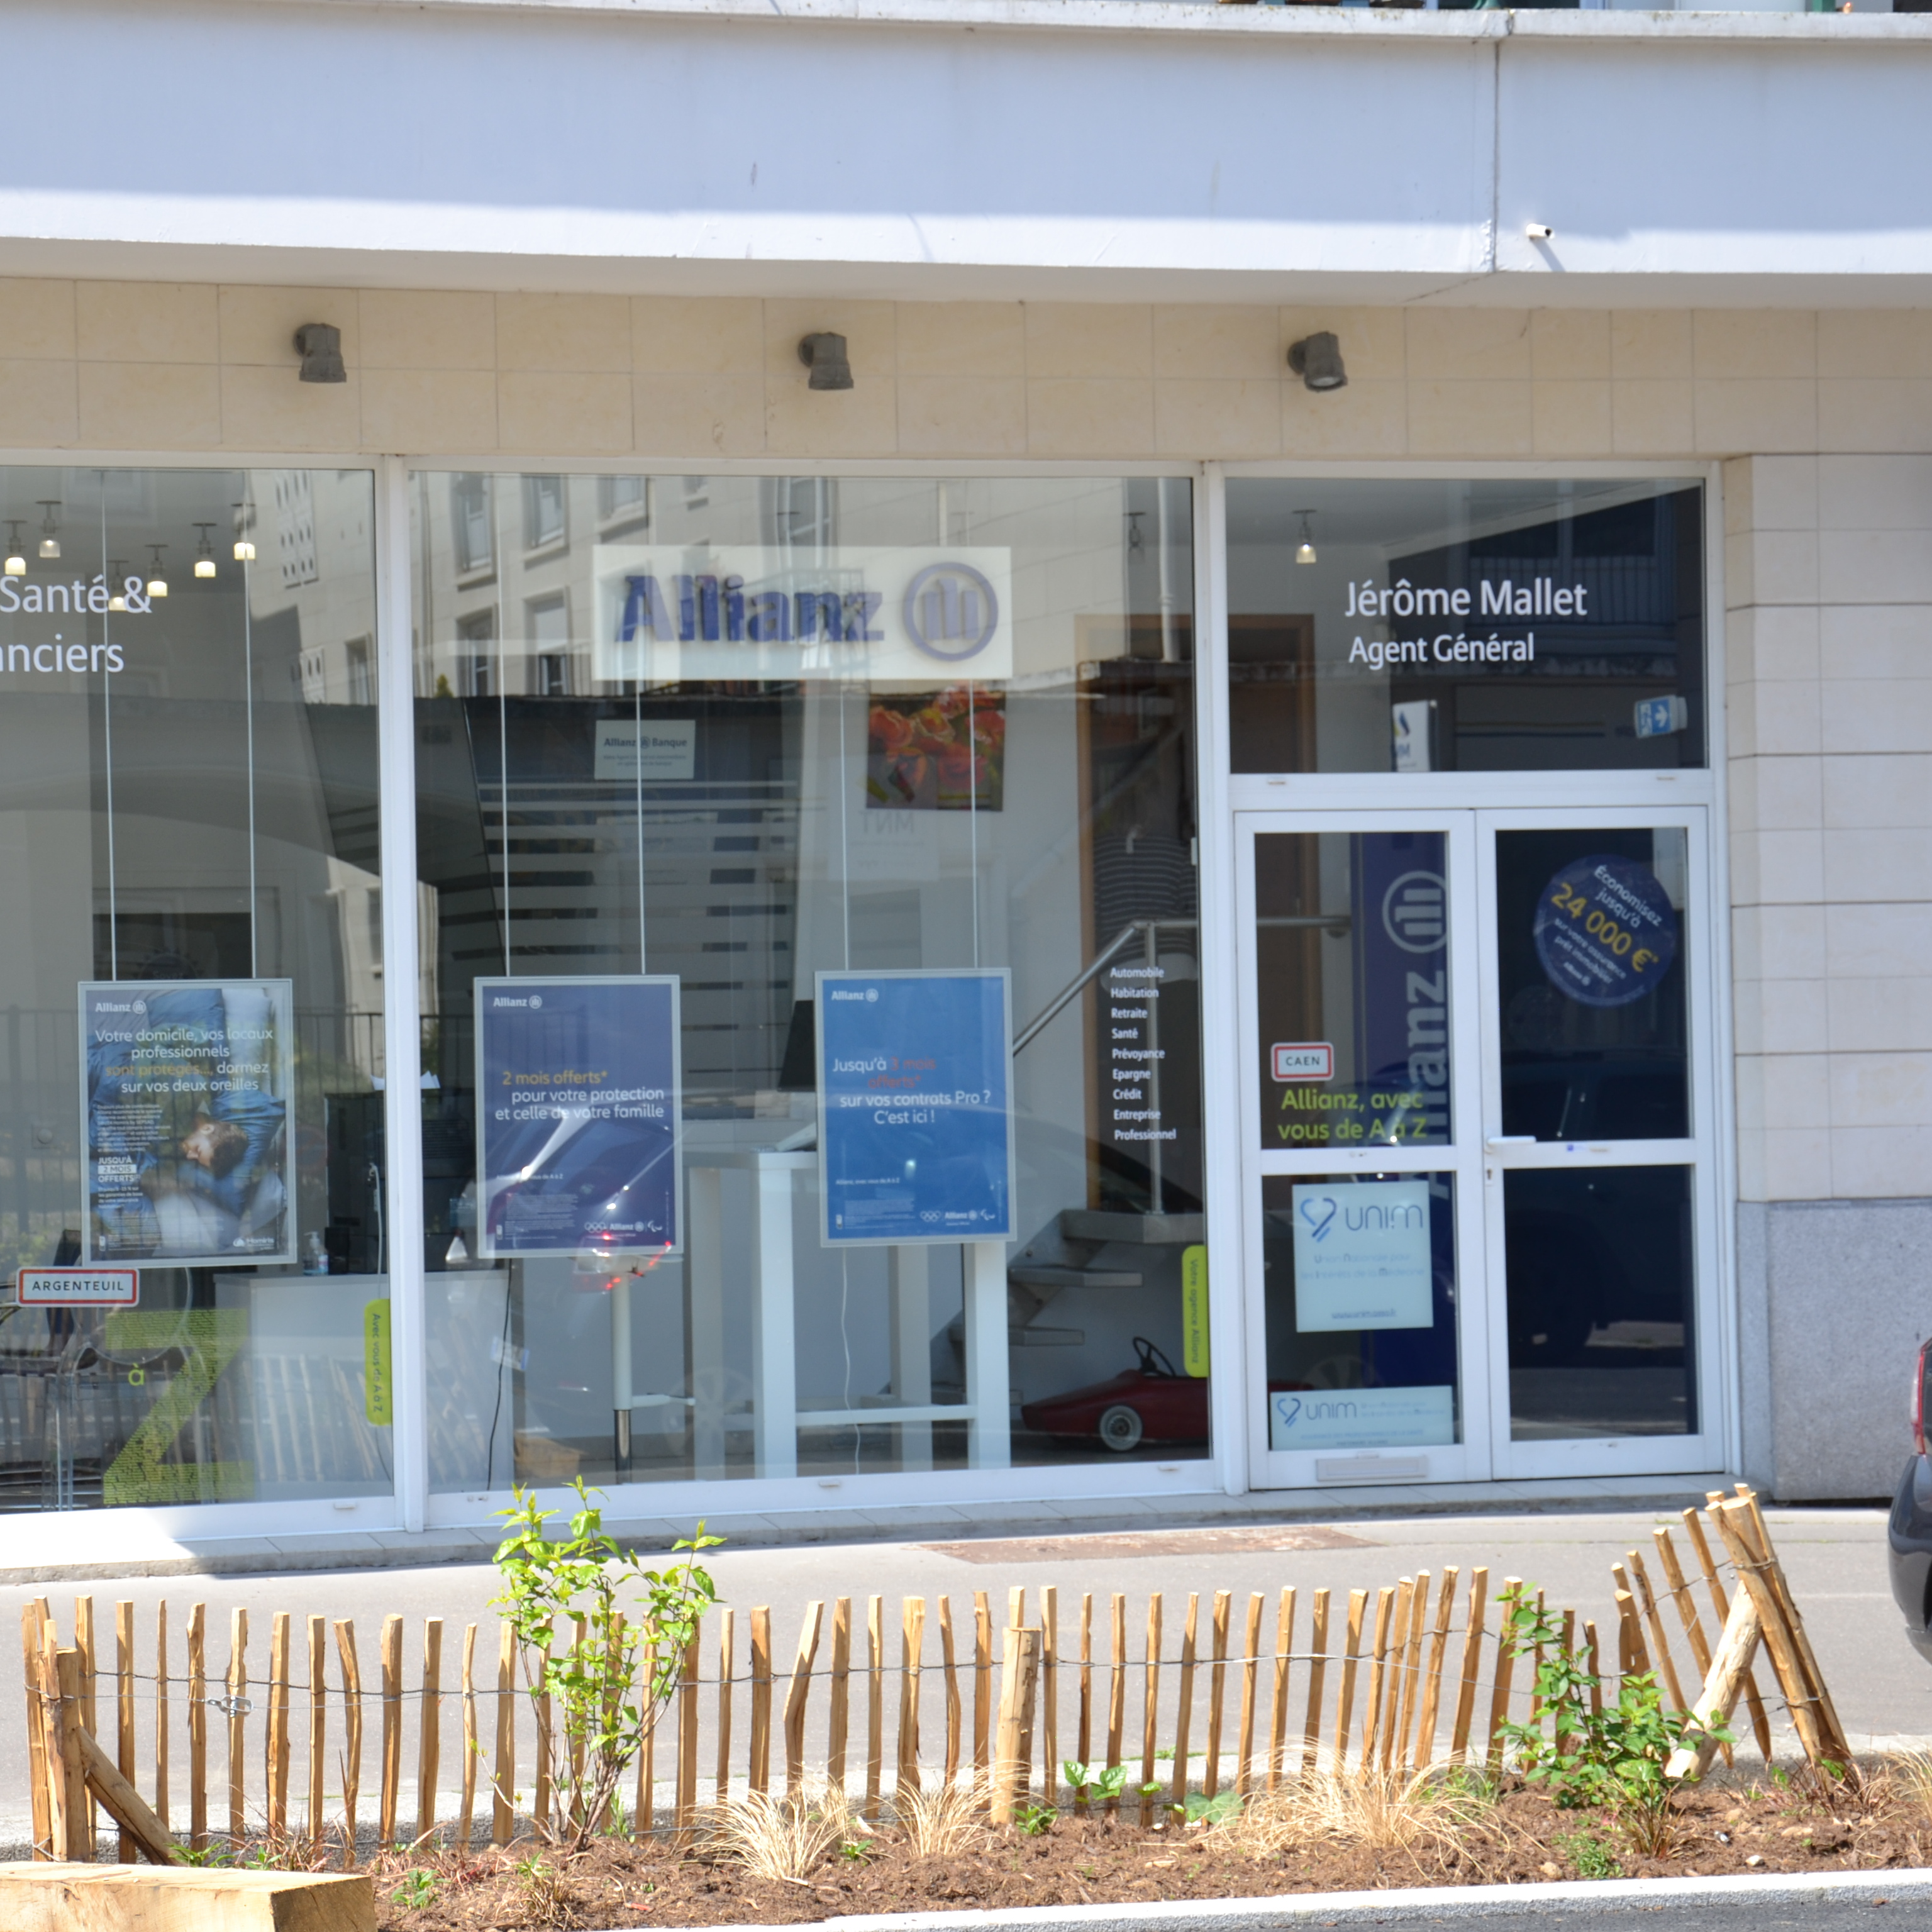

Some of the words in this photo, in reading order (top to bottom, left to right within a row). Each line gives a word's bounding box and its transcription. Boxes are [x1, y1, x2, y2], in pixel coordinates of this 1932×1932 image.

[0, 574, 109, 613] Santé
[124, 576, 152, 613] &
[1345, 578, 1471, 617] Jérôme
[1480, 577, 1587, 615] Mallet
[615, 575, 884, 642] Allianz
[1348, 636, 1428, 670] Agent
[1433, 632, 1534, 661] Général
[604, 738, 636, 747] Allianz
[652, 738, 687, 748] Banque
[1594, 865, 1662, 927] Économisez
[1596, 887, 1640, 928] jusqu'à
[1551, 882, 1587, 919] 24
[1585, 910, 1633, 955] 000
[1110, 967, 1164, 977] Automobile
[831, 991, 864, 1001] Allianz
[1111, 987, 1159, 998] Habitation
[95, 1002, 131, 1013] Allianz
[493, 997, 527, 1007] Allianz
[1111, 1007, 1148, 1018] Retraite
[95, 1030, 132, 1041] Votre
[136, 1029, 197, 1042] domicile,
[201, 1030, 224, 1040] vos
[228, 1028, 273, 1040] locaux
[1111, 1028, 1138, 1039] Santé
[132, 1045, 230, 1060] professionnels
[1112, 1048, 1165, 1062] Prévoyance
[833, 1058, 887, 1074] Jusqu'à
[891, 1057, 899, 1070] 3
[903, 1056, 936, 1070] mois
[1285, 1056, 1320, 1066] CAEN
[106, 1064, 135, 1076] sont
[217, 1062, 269, 1074] dormez
[1113, 1069, 1152, 1082] Epargne
[121, 1082, 143, 1092] sur
[145, 1082, 169, 1092] vos
[172, 1079, 207, 1092] deux
[210, 1077, 258, 1091] oreilles
[502, 1072, 512, 1085] 2
[516, 1071, 550, 1084] mois
[511, 1091, 547, 1104] pour
[550, 1089, 587, 1102] votre
[591, 1087, 664, 1104] protection
[840, 1097, 862, 1107] sur
[865, 1096, 891, 1106] vos
[894, 1092, 952, 1106] contrats
[955, 1091, 980, 1104] Pro
[1113, 1088, 1142, 1099] Crédit
[1281, 1088, 1365, 1113] Allianz,
[1370, 1092, 1423, 1109] avec
[495, 1108, 510, 1120] et
[513, 1106, 548, 1119] celle
[551, 1105, 569, 1119] de
[573, 1106, 611, 1118] votre
[614, 1104, 664, 1118] famille
[874, 1110, 909, 1124] C'est
[913, 1109, 927, 1123] ici
[1114, 1109, 1161, 1122] Entreprise
[1114, 1128, 1177, 1140] Professionnel
[1278, 1124, 1329, 1140] vous
[1335, 1118, 1363, 1139] de
[1369, 1119, 1385, 1138] A
[1412, 1118, 1427, 1138] Z
[98, 1155, 132, 1165] JUSQU'À
[32, 1281, 124, 1291] ARGENTEUIL
[372, 1313, 381, 1338] Avec
[372, 1341, 380, 1365] vous
[128, 1363, 145, 1386] à
[373, 1368, 382, 1382] de
[373, 1385, 382, 1393] A
